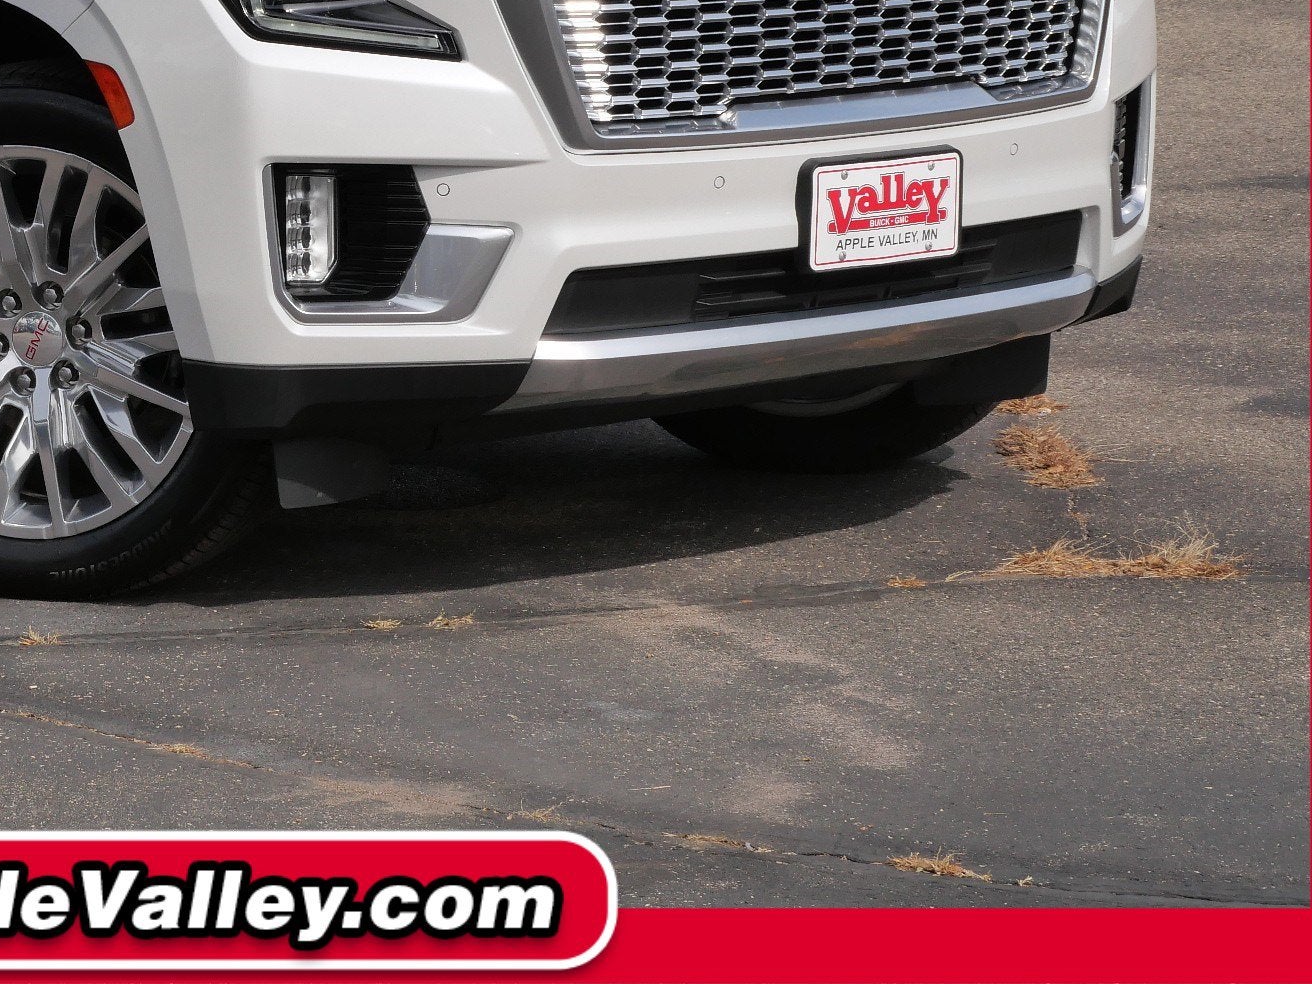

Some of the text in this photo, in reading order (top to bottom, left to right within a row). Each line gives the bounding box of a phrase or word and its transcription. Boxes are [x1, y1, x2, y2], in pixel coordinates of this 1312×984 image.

[826, 171, 950, 235] Valley
[869, 215, 909, 228] BUICK GMC
[836, 228, 938, 252] APPLE VALLEY, MN
[25, 317, 50, 360] GMC
